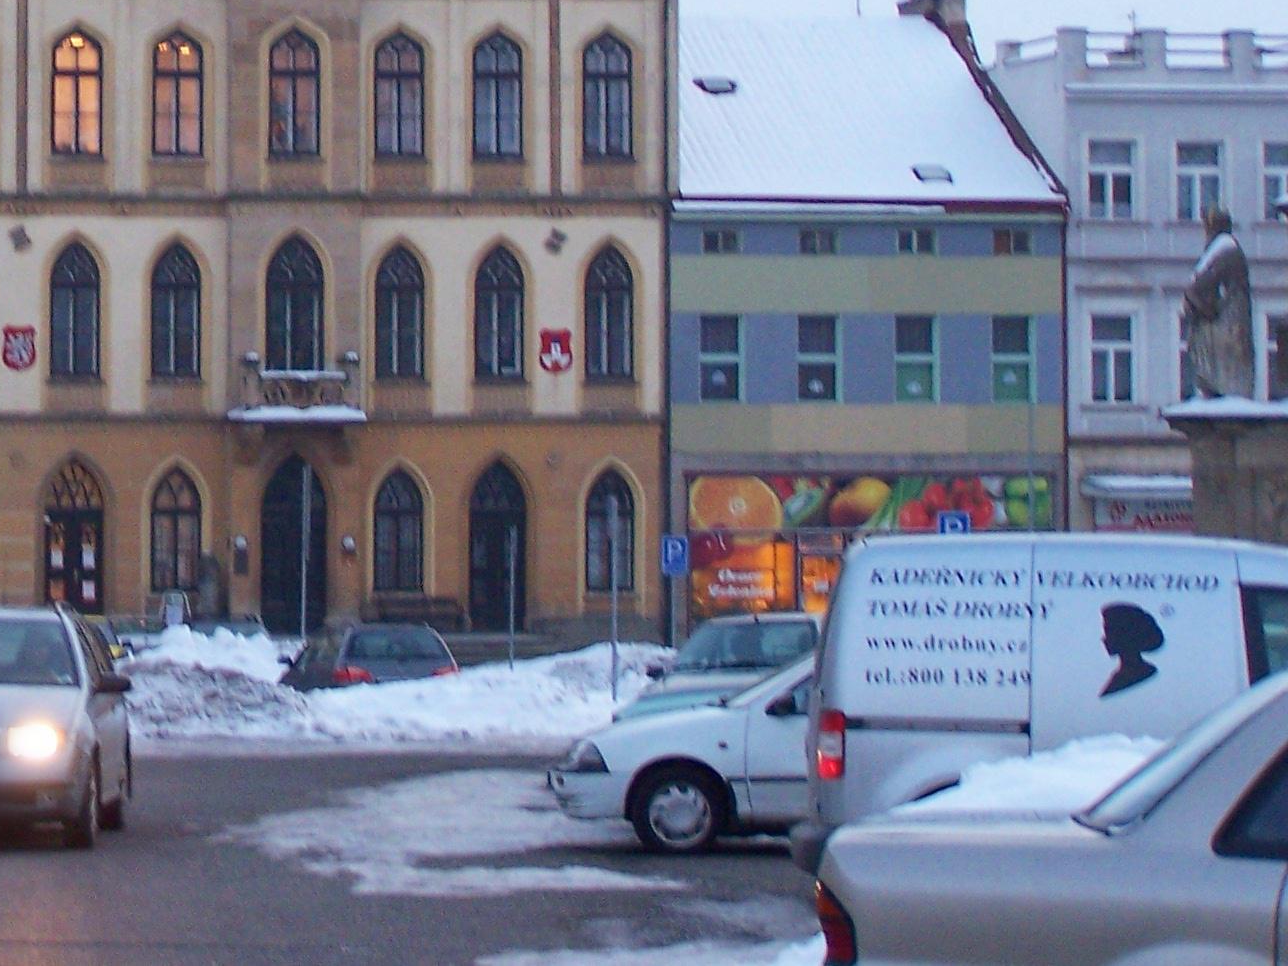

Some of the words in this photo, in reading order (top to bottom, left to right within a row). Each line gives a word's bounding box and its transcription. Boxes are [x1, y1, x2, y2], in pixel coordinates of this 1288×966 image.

[667, 540, 683, 563] P
[1036, 569, 1219, 591] VELKOOBCHOD
[868, 597, 947, 617] TOMÁŠ
[952, 598, 1054, 620] DROBNÝ
[865, 634, 1028, 657] www.drobny.cz
[994, 668, 1032, 686] 249
